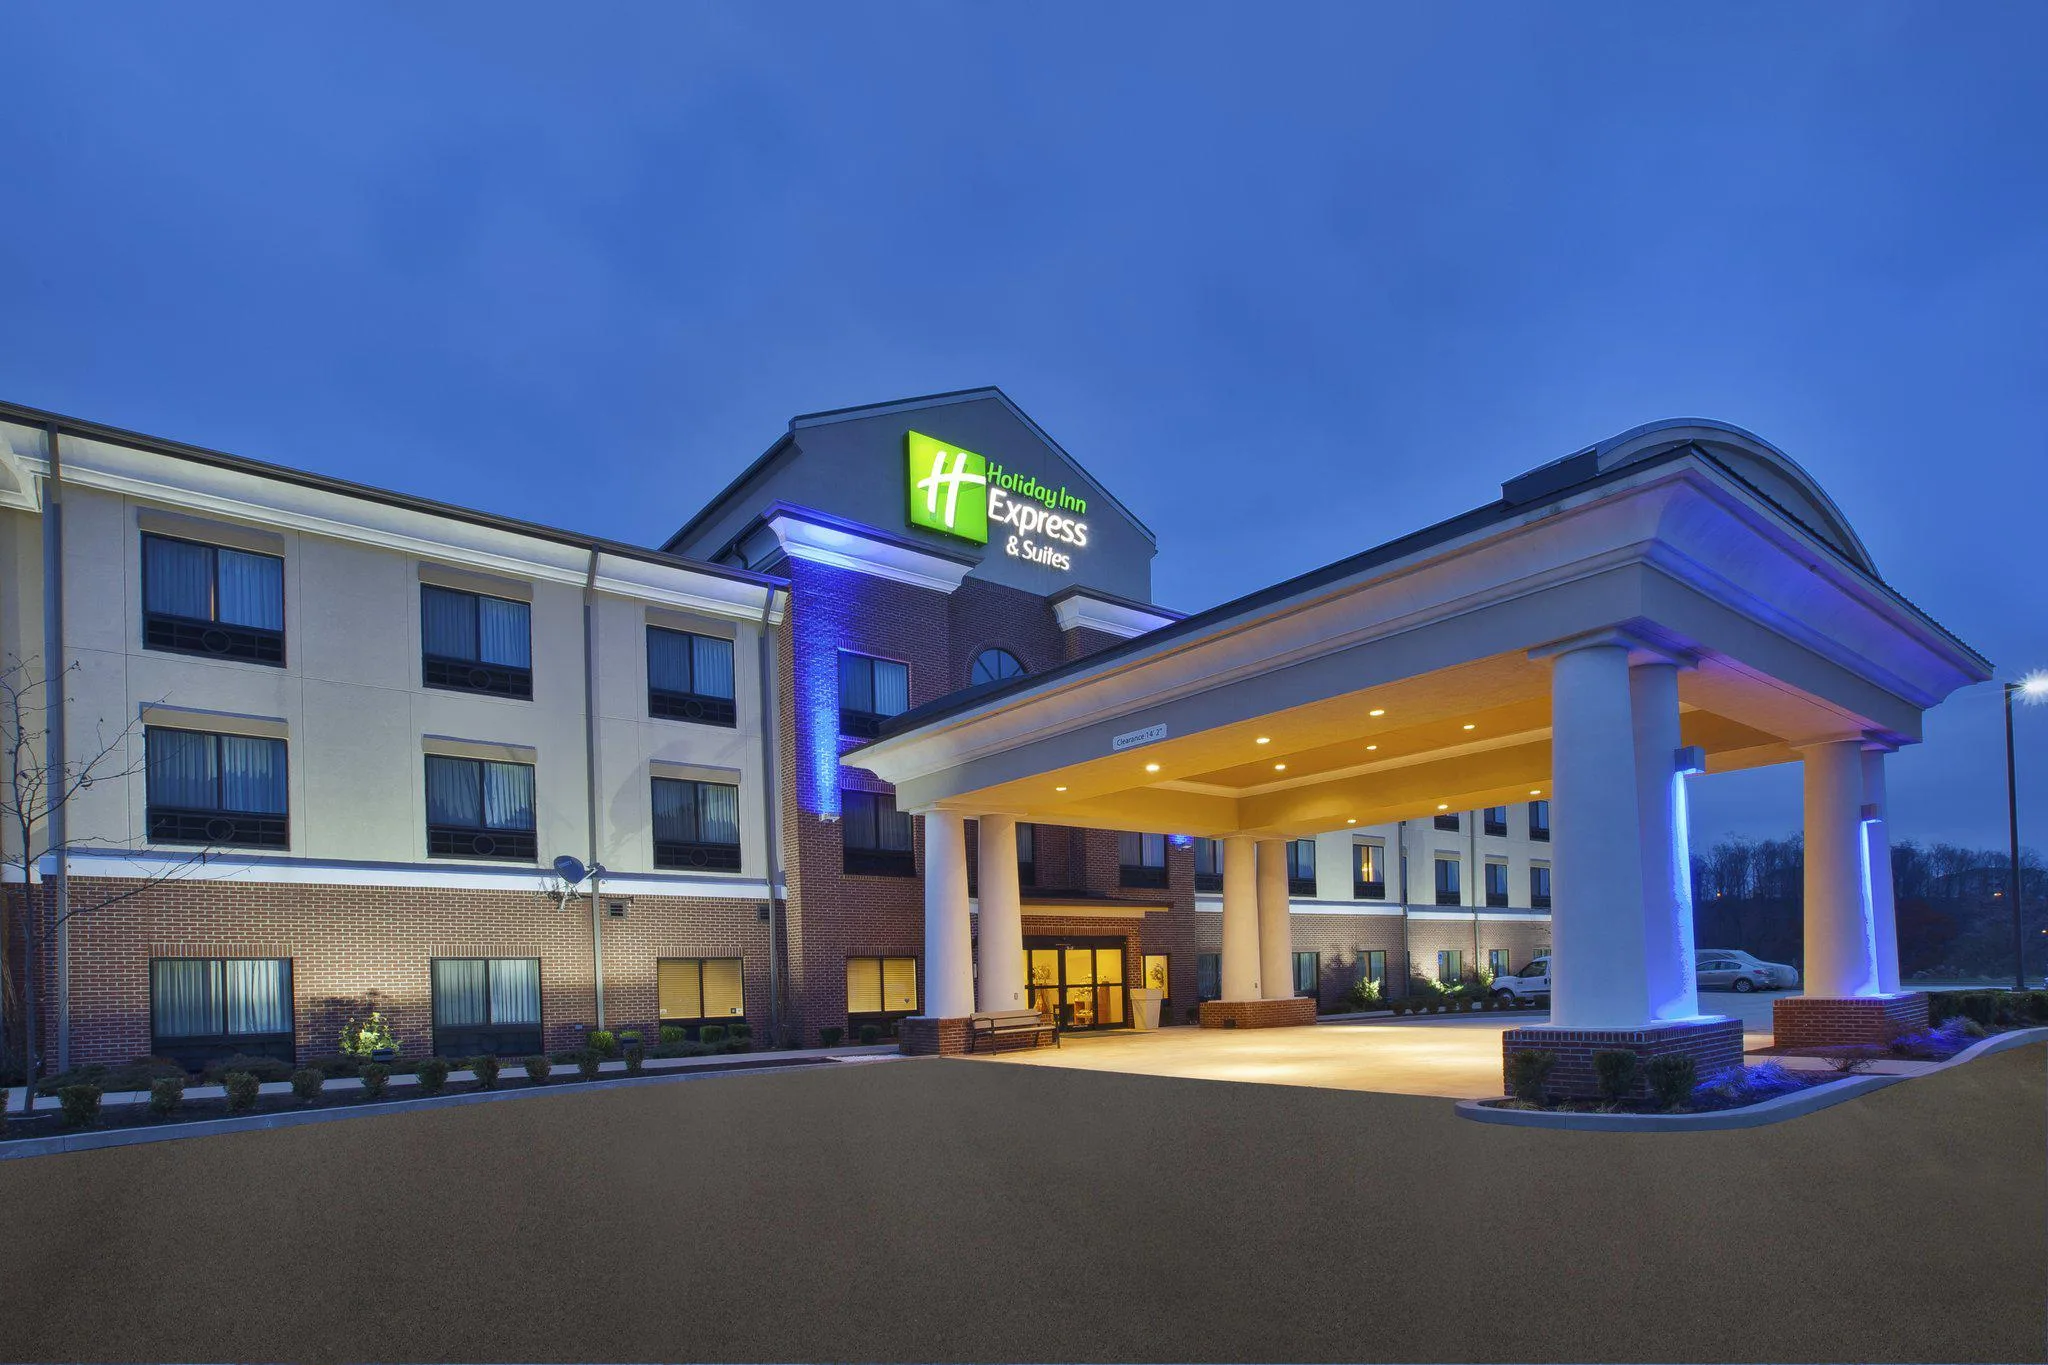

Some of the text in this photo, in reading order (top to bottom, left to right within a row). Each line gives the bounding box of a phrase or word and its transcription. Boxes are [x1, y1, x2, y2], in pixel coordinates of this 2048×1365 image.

[987, 462, 1087, 514] Holiday Inn
[988, 487, 1088, 546] Express
[1006, 535, 1070, 571] & Suites
[1116, 733, 1145, 747] Clearance
